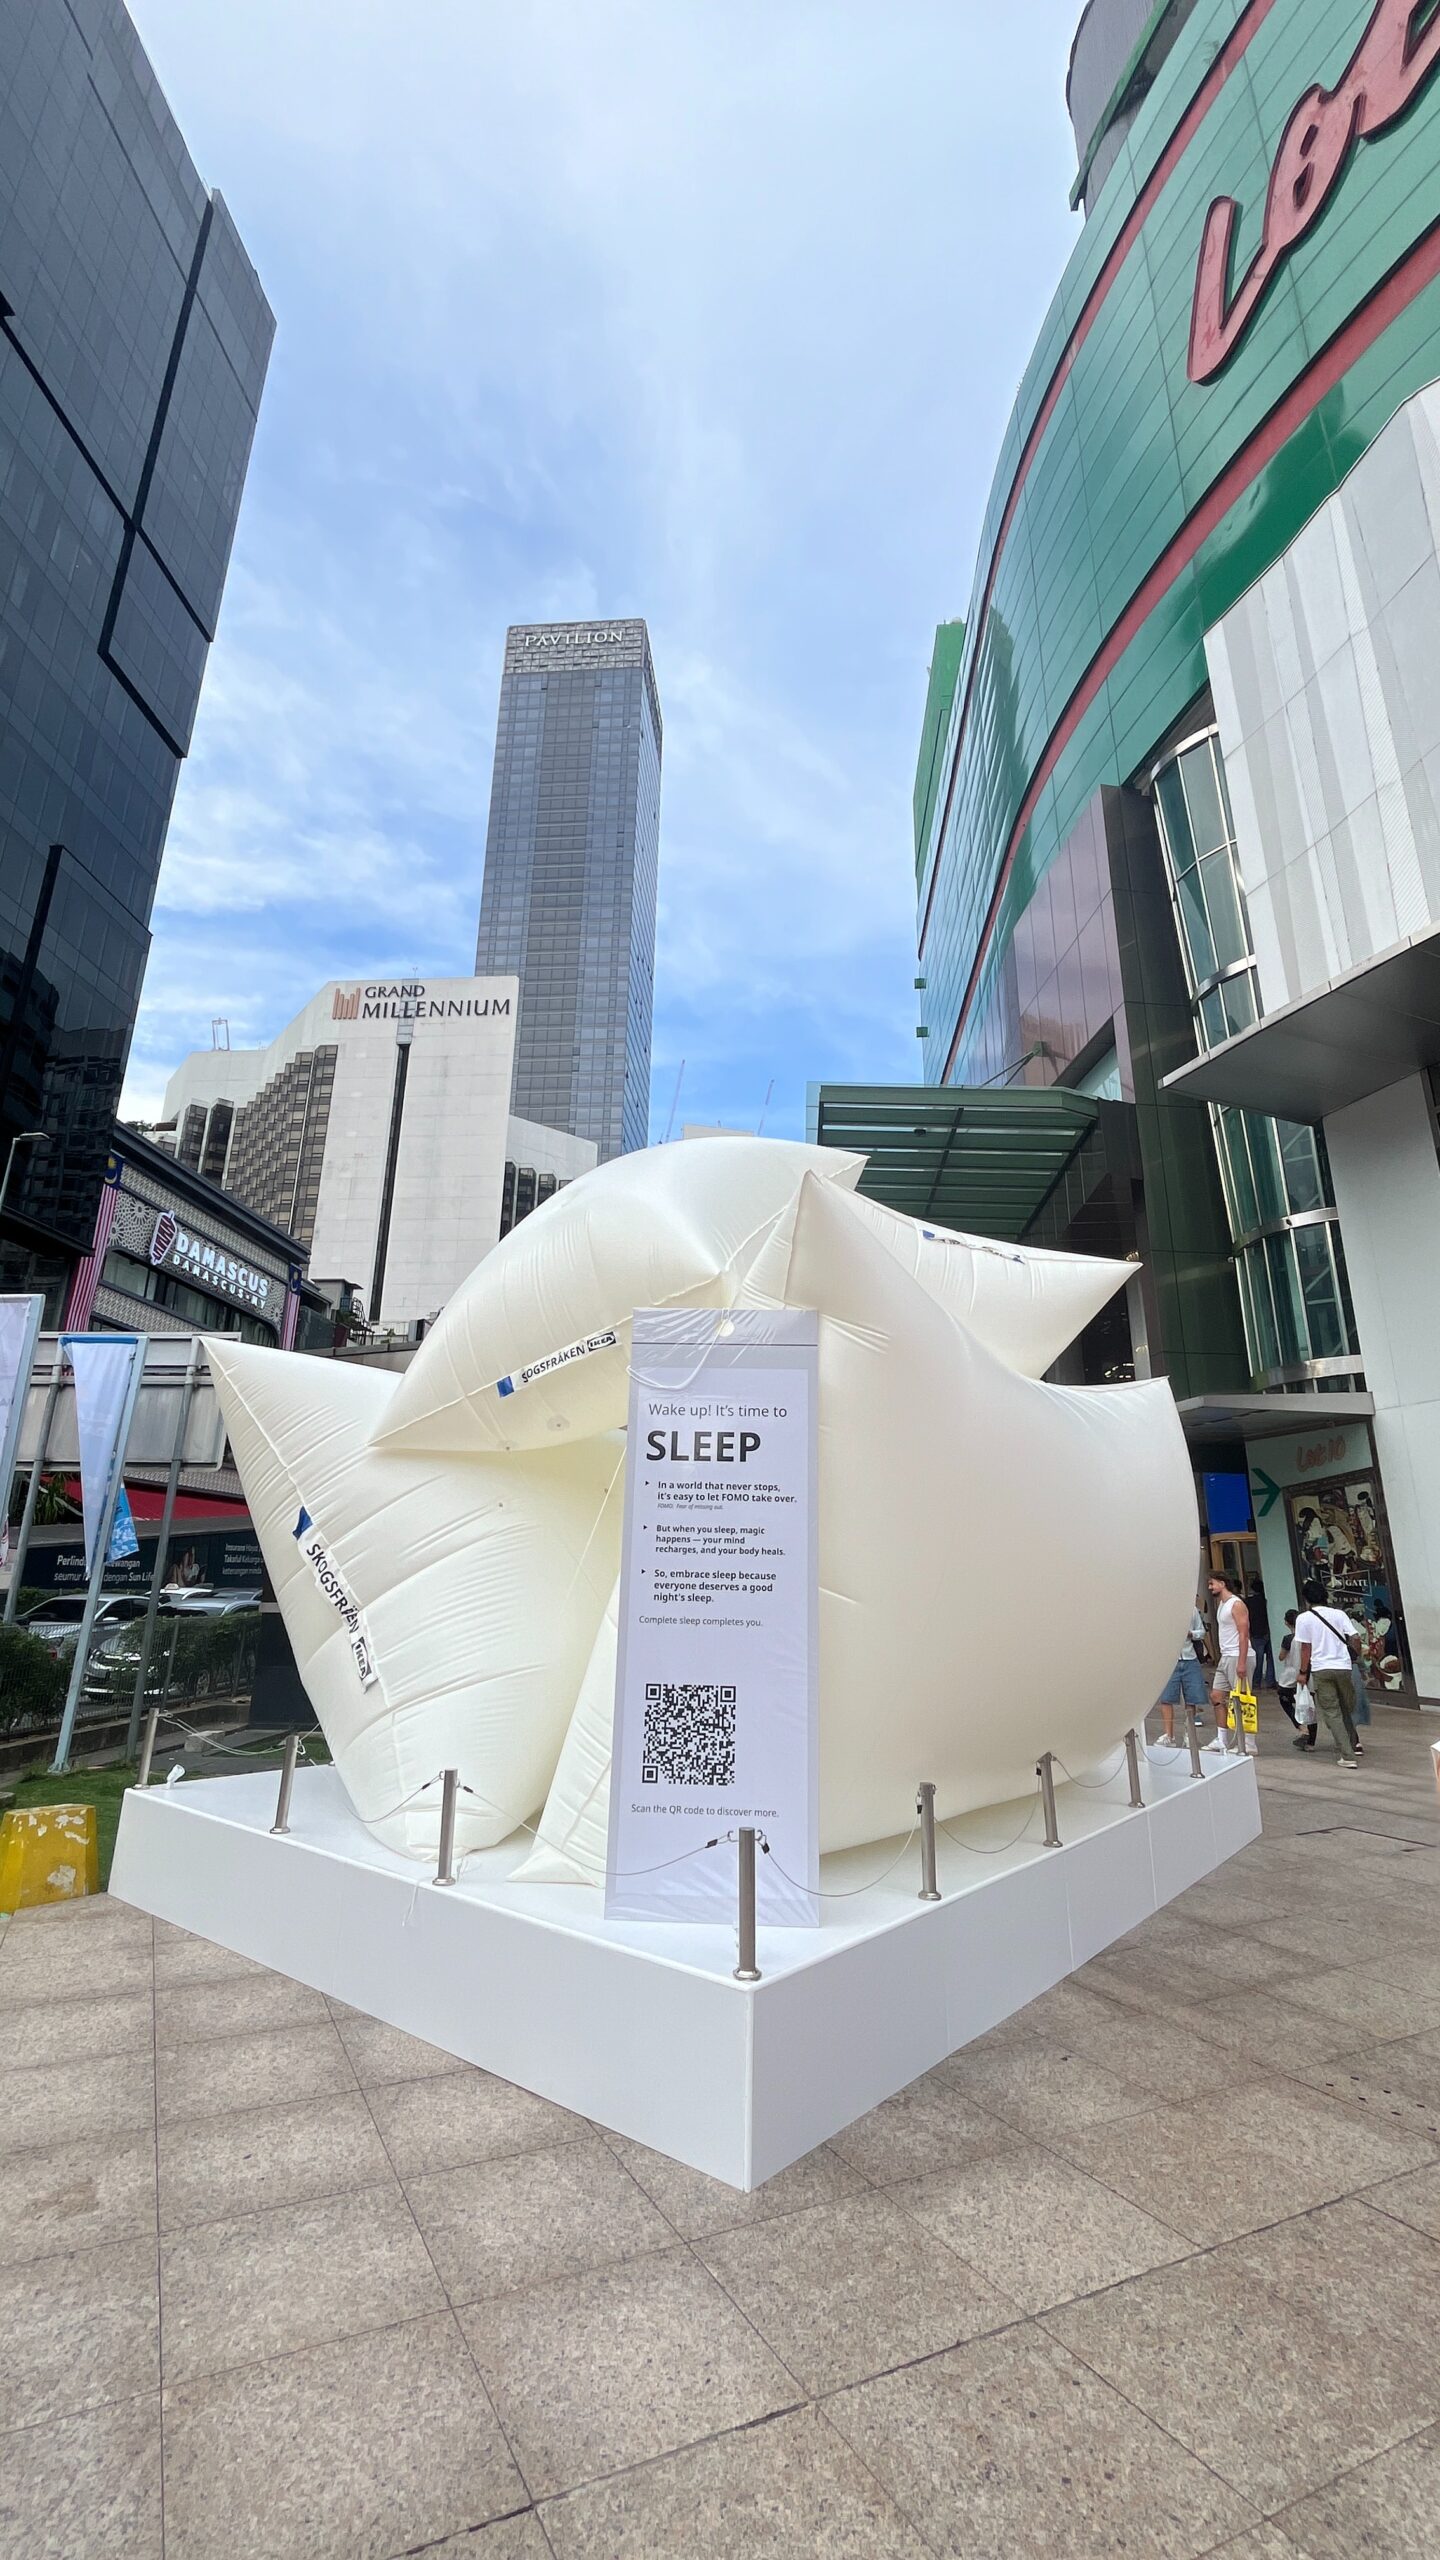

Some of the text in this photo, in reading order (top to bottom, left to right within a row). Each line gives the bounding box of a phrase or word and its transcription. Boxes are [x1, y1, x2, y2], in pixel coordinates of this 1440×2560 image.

[525, 631, 623, 647] PAVILION
[365, 985, 425, 998] GRAND
[362, 999, 510, 1019] MILLENNIUM
[176, 1232, 268, 1297] DAMASCUS
[588, 1334, 614, 1349] IKEA
[648, 1403, 787, 1419] Wake up! It's time to
[646, 1429, 761, 1462] SLEEP
[658, 1481, 667, 1489] In
[677, 1481, 702, 1490] world
[705, 1482, 724, 1490] that
[726, 1483, 752, 1491] never
[754, 1483, 780, 1492] stops,
[657, 1492, 797, 1503] it's easy to let FOMO take over.
[656, 1524, 765, 1536] But when you sleep, magic
[656, 1535, 691, 1543] happens
[703, 1537, 722, 1545] your
[723, 1536, 745, 1545] mind
[655, 1546, 786, 1557] recharges, and your body heals.
[128, 1571, 141, 1581] Sun
[654, 1569, 777, 1581] So, embrace sleep because
[654, 1582, 697, 1591] everyone
[699, 1582, 739, 1591] deserves
[749, 1583, 773, 1593] good
[653, 1592, 714, 1604] night's sleep.
[639, 1615, 763, 1629] Complete sleep completes you.
[353, 1640, 369, 1678] IKEA
[631, 1803, 780, 1818] Scan the QR code to discover more.
